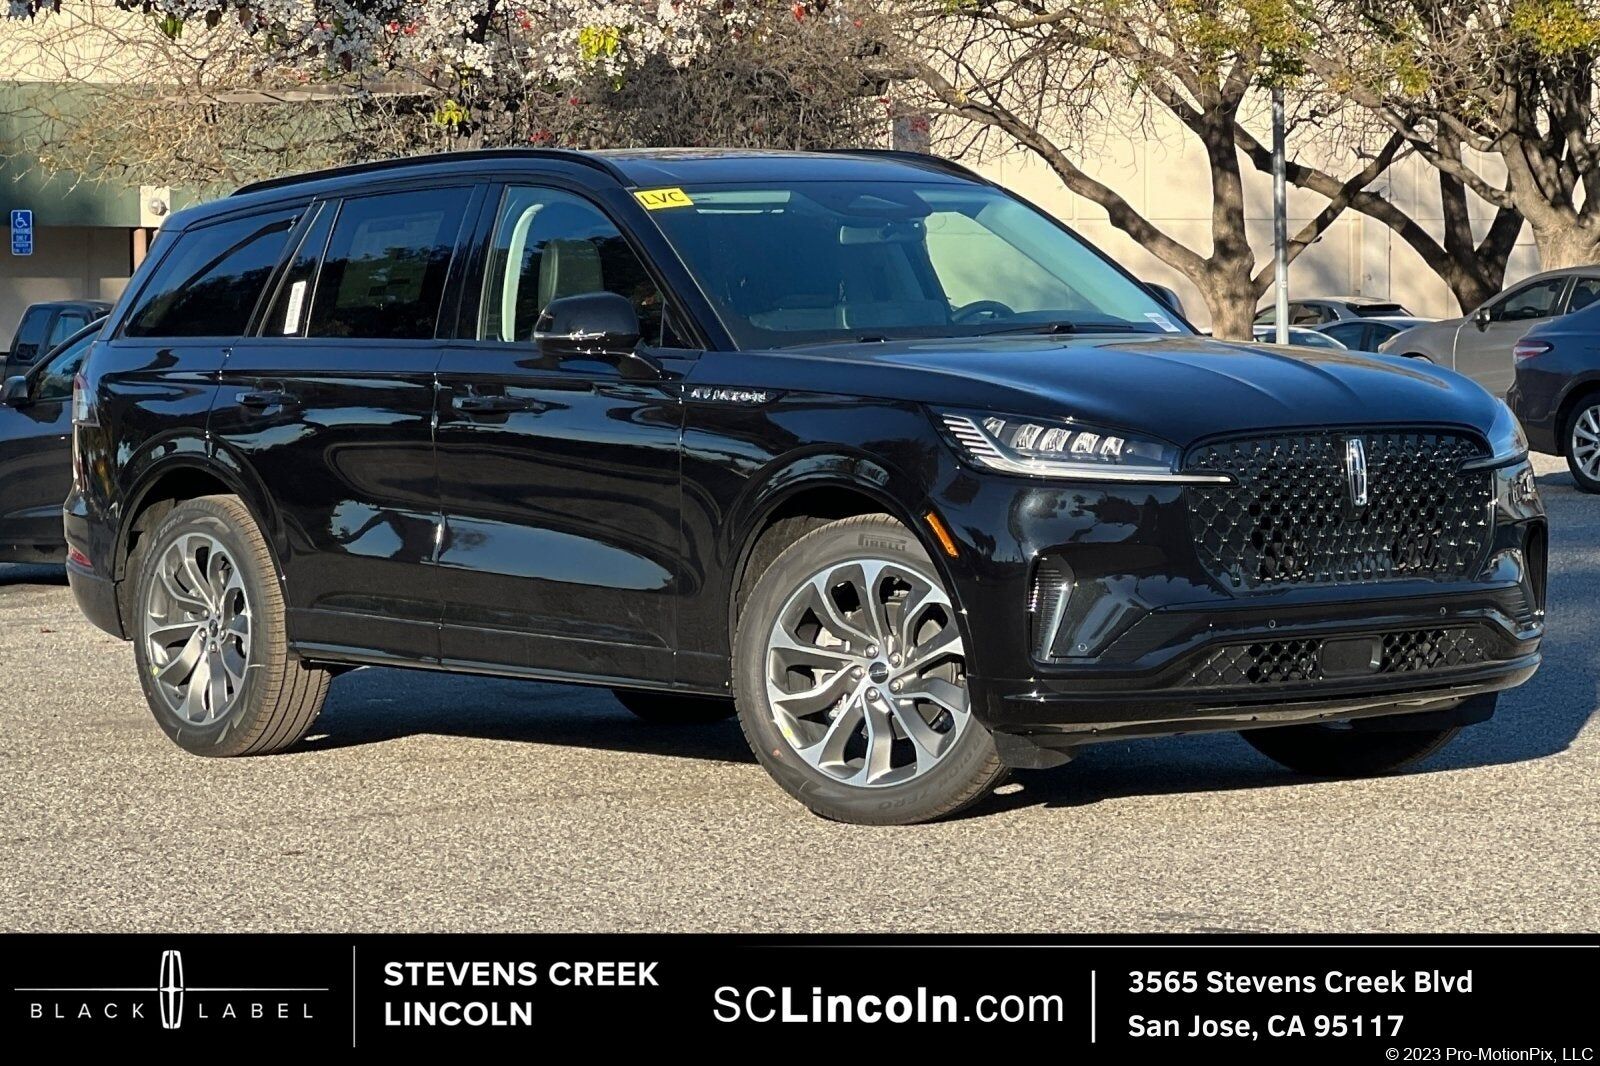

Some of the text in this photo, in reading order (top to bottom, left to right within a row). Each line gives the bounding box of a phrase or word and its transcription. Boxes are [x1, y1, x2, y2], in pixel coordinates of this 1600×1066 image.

[641, 191, 685, 205] LVC
[690, 388, 767, 403] AVIATOR
[857, 533, 908, 552] PIRELLI
